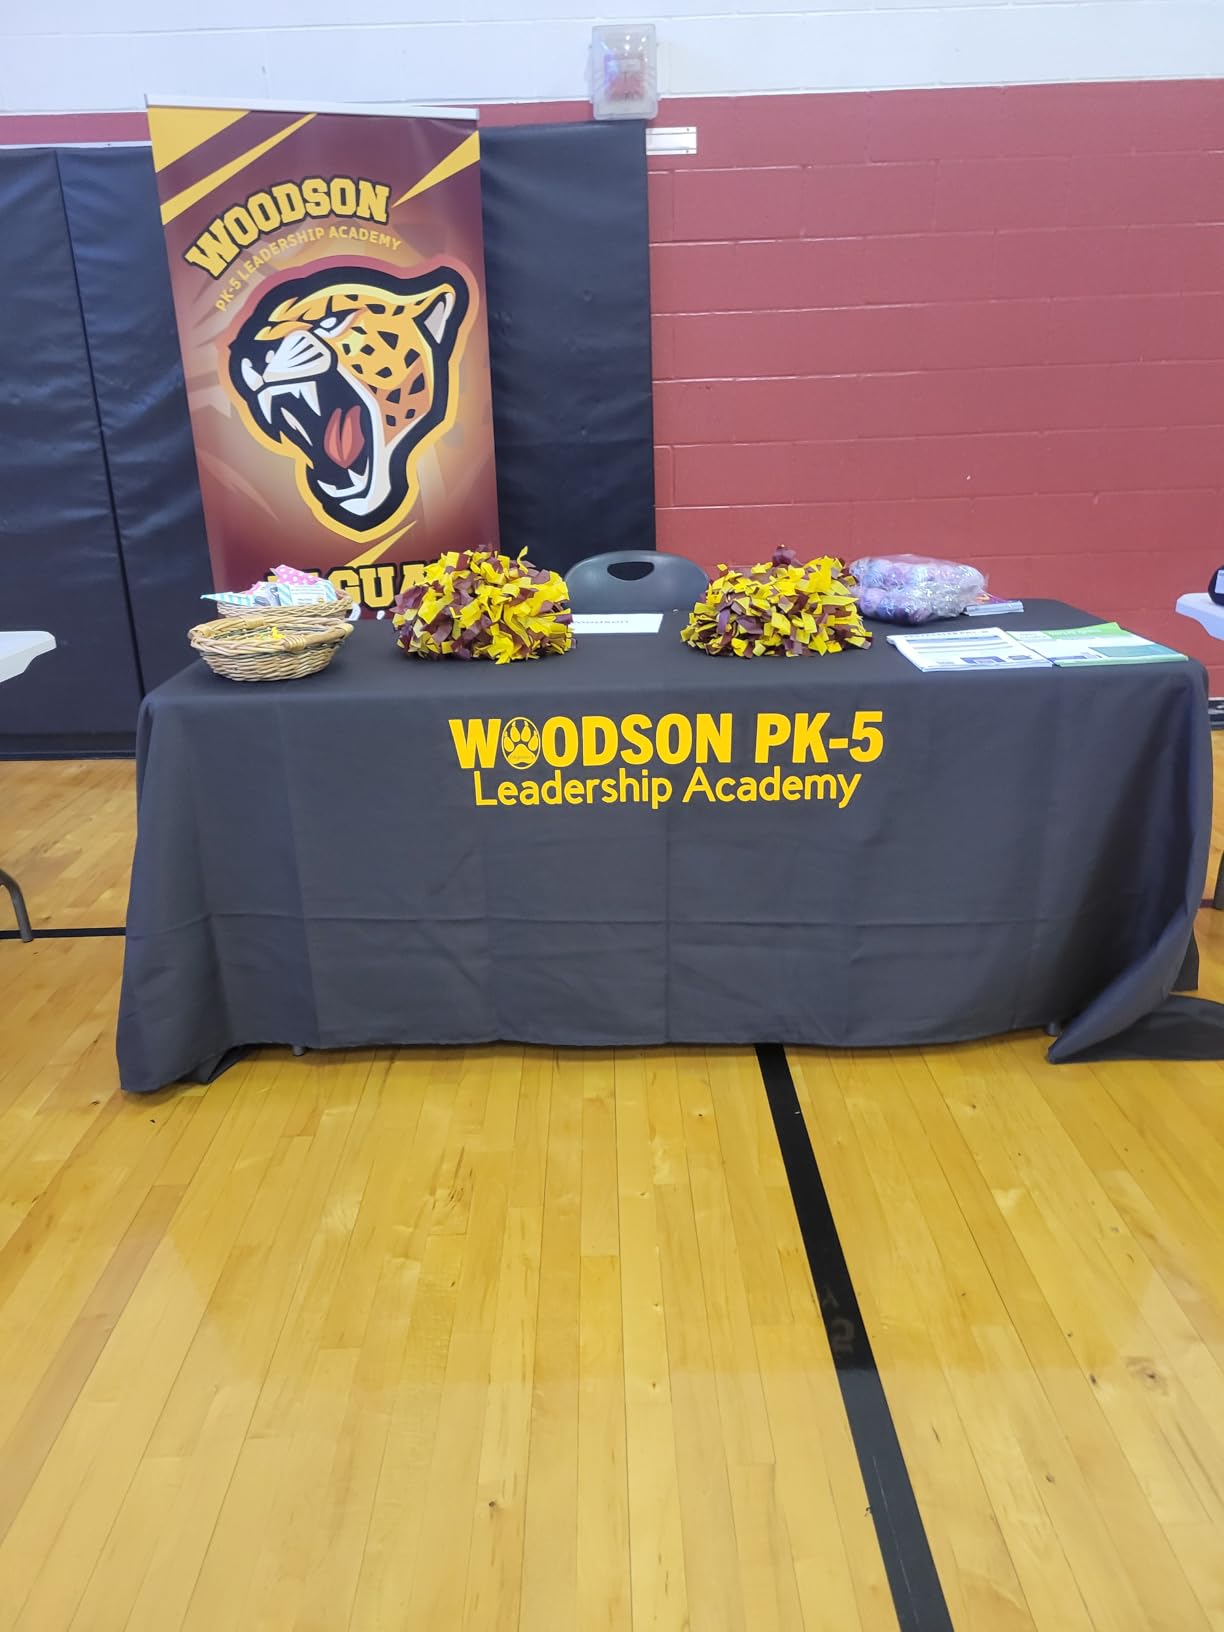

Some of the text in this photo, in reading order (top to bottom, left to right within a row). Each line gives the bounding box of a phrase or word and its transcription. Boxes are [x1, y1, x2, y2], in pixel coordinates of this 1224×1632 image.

[183, 177, 390, 278] WOODSON
[215, 225, 402, 312] PK-5 LEADERSHIP ACADEMY
[754, 710, 885, 765] PK-5
[473, 765, 862, 810] Leadership Academy
